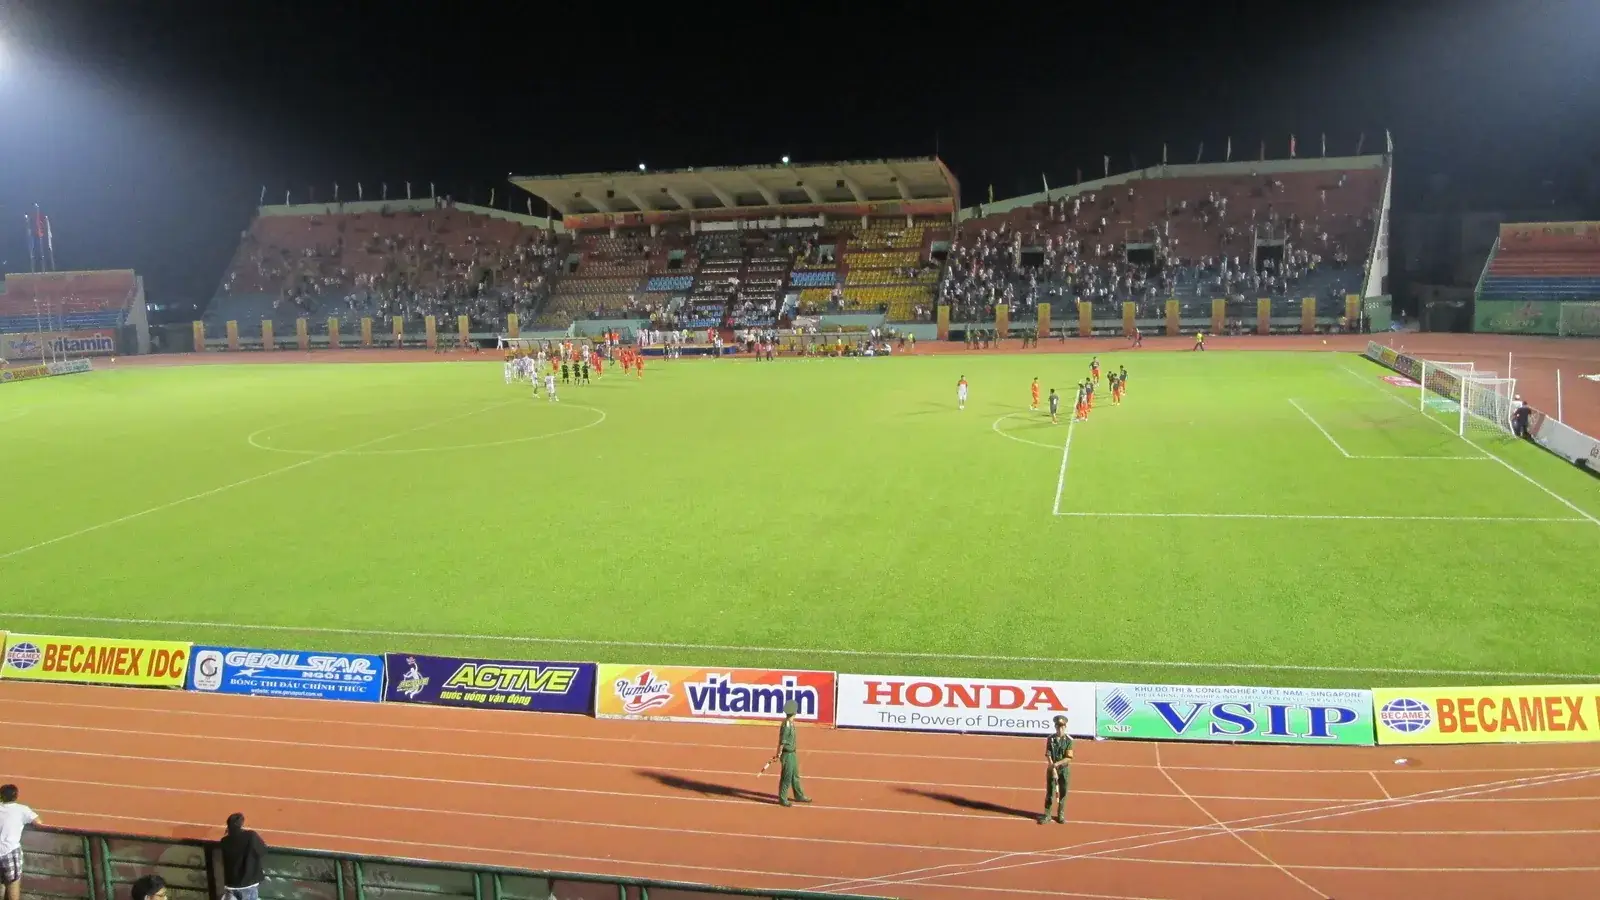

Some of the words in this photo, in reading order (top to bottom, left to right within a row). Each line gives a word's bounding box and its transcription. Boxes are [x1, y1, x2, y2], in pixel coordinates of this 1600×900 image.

[7, 652, 41, 660] BECAMEX
[42, 643, 144, 676] BECAMEX
[146, 648, 185, 679] IDC
[306, 655, 377, 674] STAR
[343, 673, 373, 682] SAO
[443, 663, 578, 693] ACTIVE
[616, 677, 668, 698] Number
[632, 671, 651, 704] 1
[687, 676, 816, 716] vitamin
[863, 681, 1068, 711] HONDA
[878, 711, 907, 724] The
[911, 713, 962, 726] Power
[965, 715, 983, 726] of
[987, 715, 1050, 729] Dreams
[1145, 700, 1358, 738] VSIP
[1380, 711, 1431, 720] BECAMEX
[1436, 696, 1588, 733] BECAMEX
